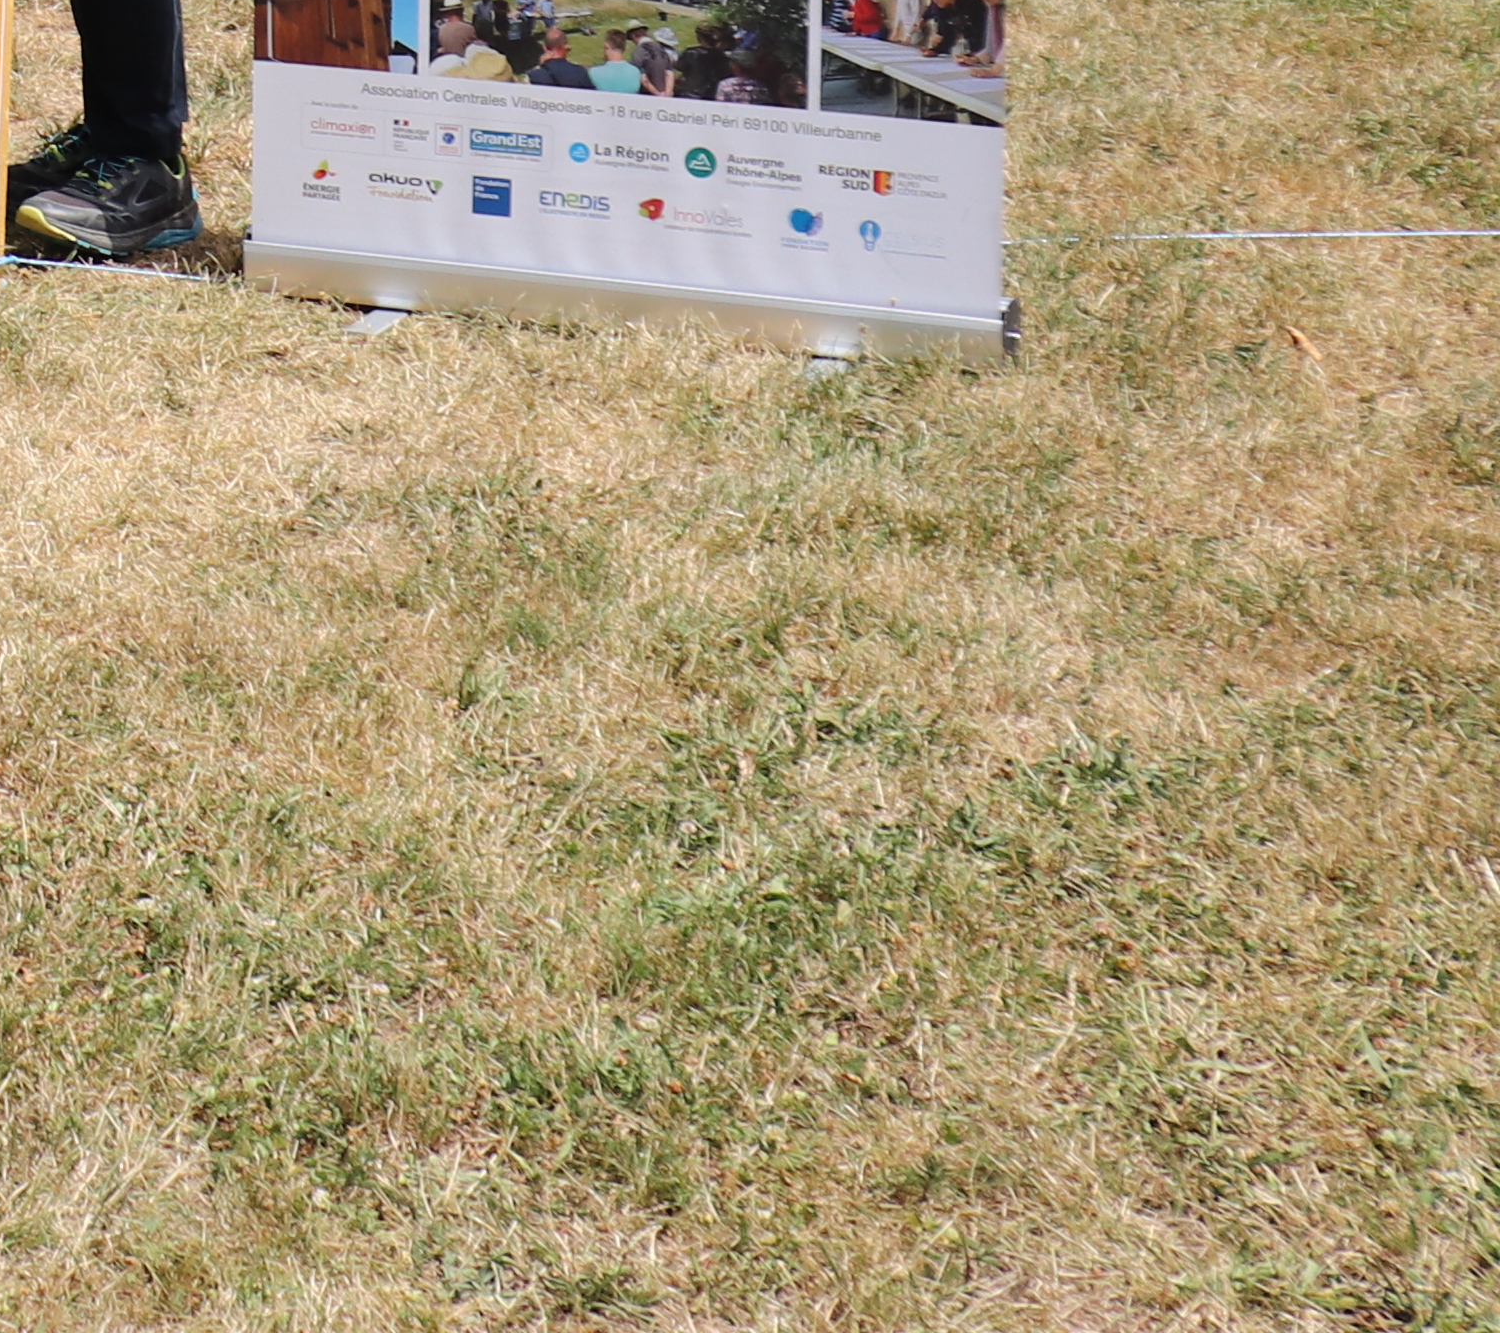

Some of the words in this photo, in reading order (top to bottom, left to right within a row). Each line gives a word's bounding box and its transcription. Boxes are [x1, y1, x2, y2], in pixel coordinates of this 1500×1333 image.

[360, 82, 440, 101] Association
[442, 89, 507, 108] Centrales
[511, 95, 592, 115] Villageoises
[609, 105, 626, 118] 18
[630, 109, 652, 121] rue
[656, 109, 707, 126] Gabriel
[711, 114, 739, 129] Péri
[743, 117, 788, 133] 69100
[793, 121, 882, 143] Villeurbanne
[471, 131, 517, 146] Grand
[518, 135, 542, 149] Est
[594, 144, 612, 157] La
[616, 145, 670, 163] Région
[727, 153, 785, 169] Auvergne
[368, 172, 424, 187] akuo
[726, 165, 802, 183] Rhône-Alpes
[818, 163, 871, 179] RÉGION
[842, 179, 871, 191] SUD
